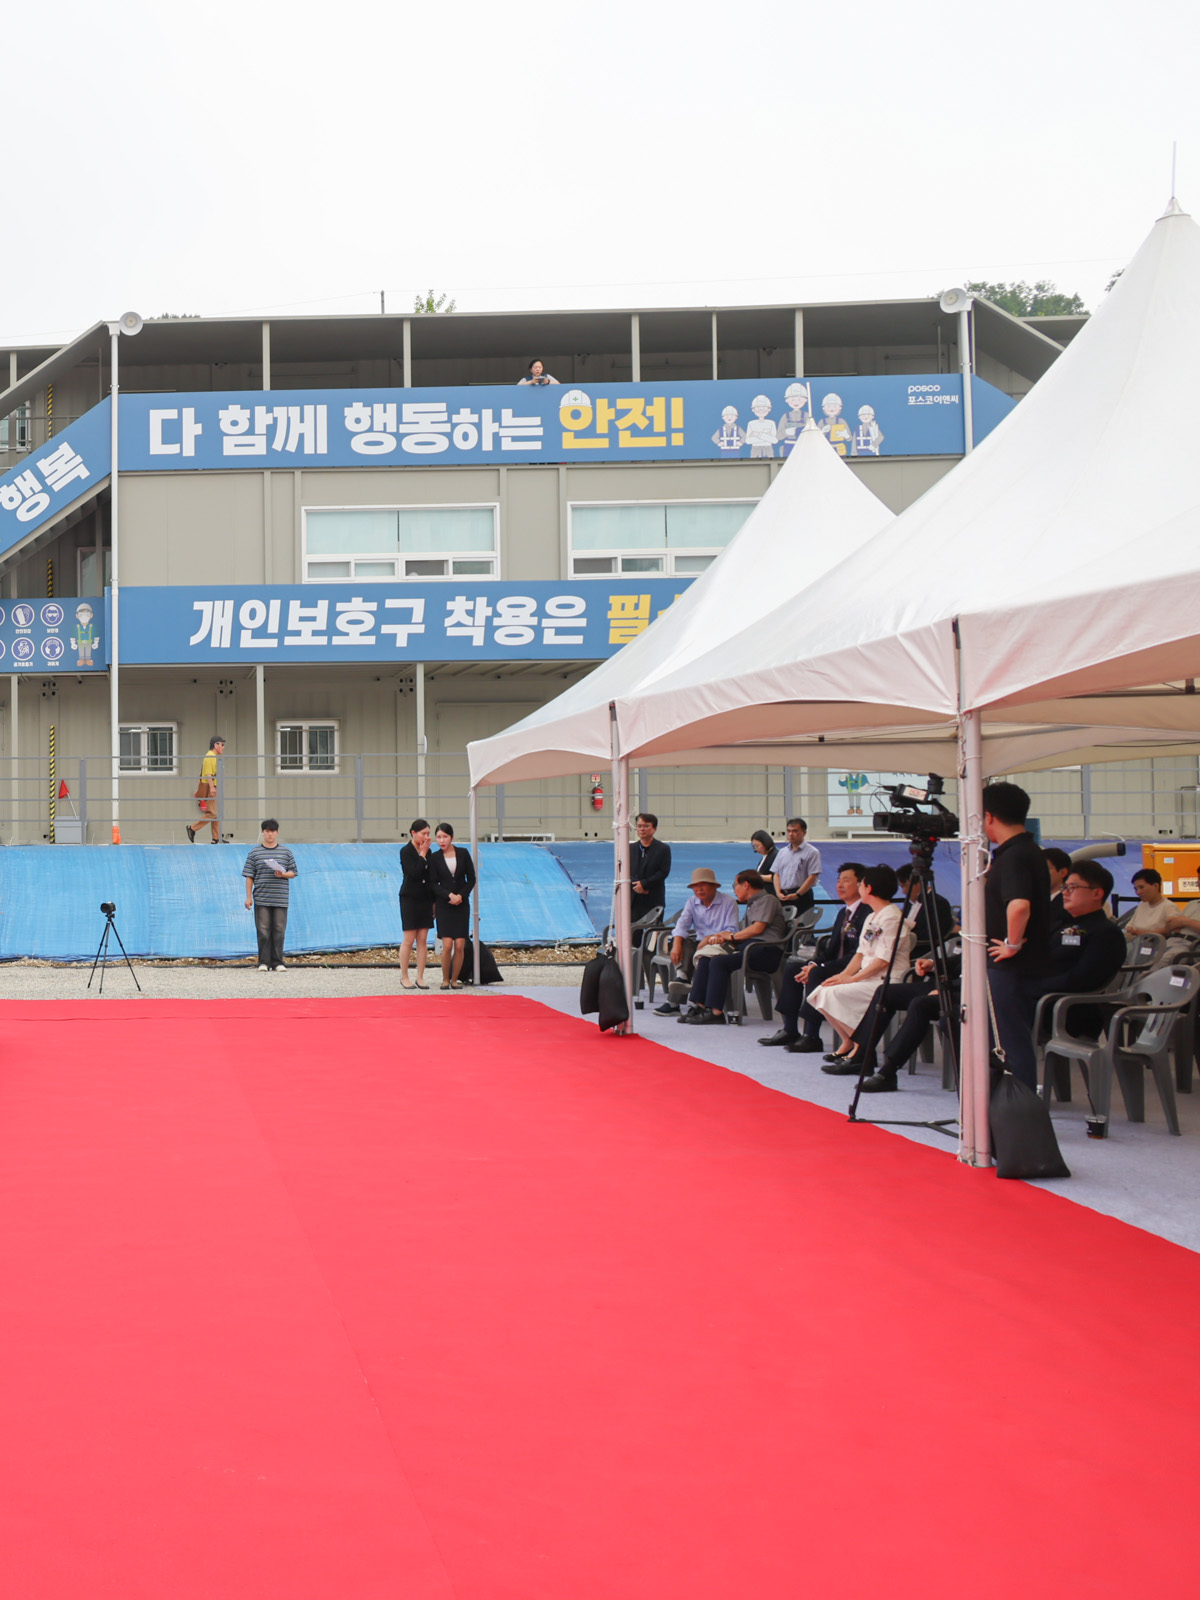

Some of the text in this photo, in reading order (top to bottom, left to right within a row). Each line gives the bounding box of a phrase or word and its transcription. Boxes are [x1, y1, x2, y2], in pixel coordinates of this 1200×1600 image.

[908, 385, 941, 394] posco
[908, 395, 959, 405] 포스코이앤씨
[148, 396, 685, 457] 다 함께 행동하는 안전!
[189, 594, 682, 649] 개인보호구 착용은 필
